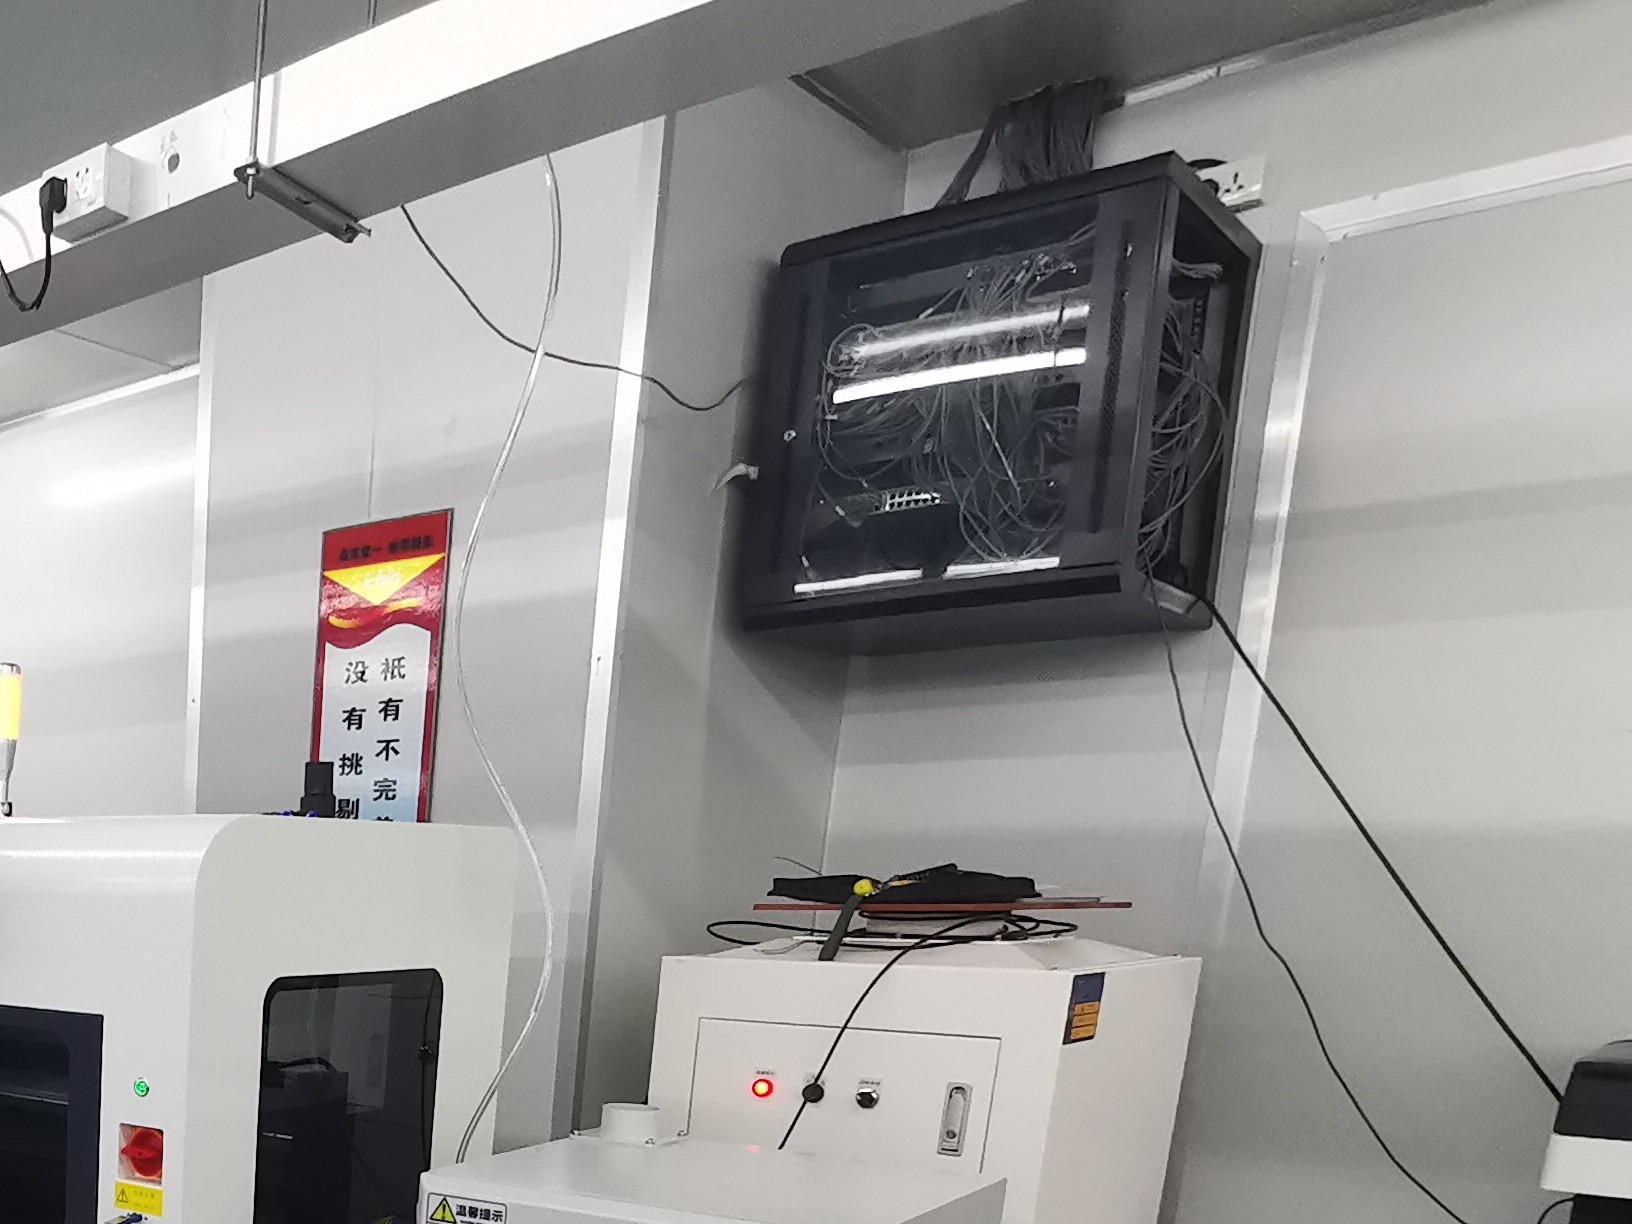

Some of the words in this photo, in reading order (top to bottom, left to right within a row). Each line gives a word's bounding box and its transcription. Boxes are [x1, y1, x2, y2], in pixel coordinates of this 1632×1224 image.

[335, 660, 369, 820] 没有挑剔
[372, 656, 407, 822] 祇有不完
[455, 1203, 504, 1223] 温馨提示
